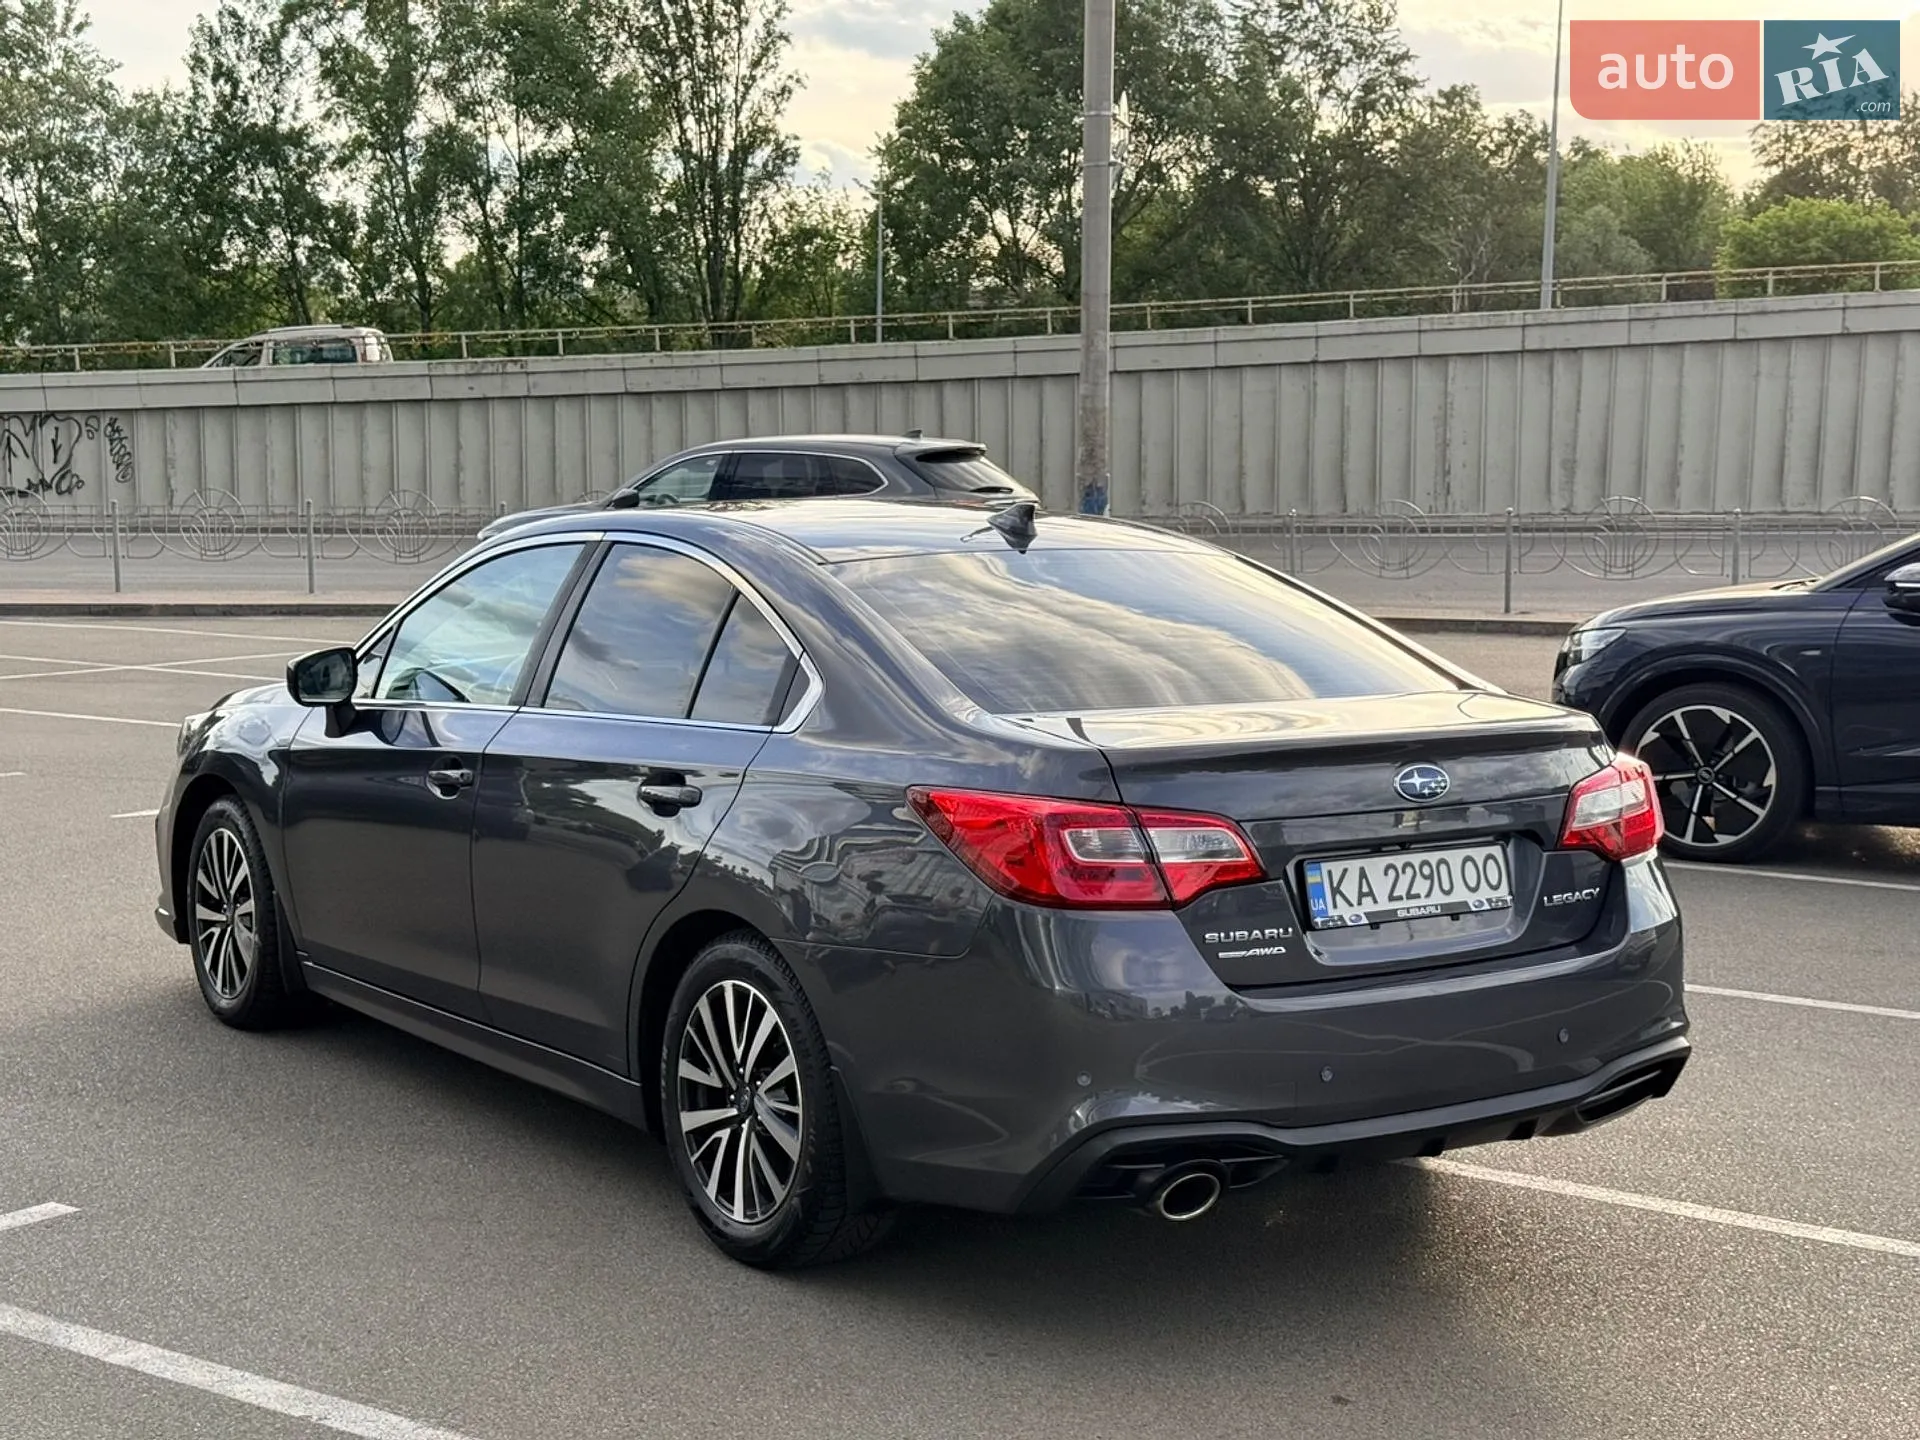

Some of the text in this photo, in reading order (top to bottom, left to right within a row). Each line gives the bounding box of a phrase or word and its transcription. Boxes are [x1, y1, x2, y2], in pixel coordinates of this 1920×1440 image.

[1326, 866, 1379, 909] KA
[1383, 859, 1454, 903] 2290
[1311, 898, 1327, 911] UA
[1543, 887, 1600, 907] LEGACY
[1397, 905, 1441, 918] SUBARU
[1204, 927, 1293, 944] SUBARU
[1244, 946, 1287, 958] AWD
